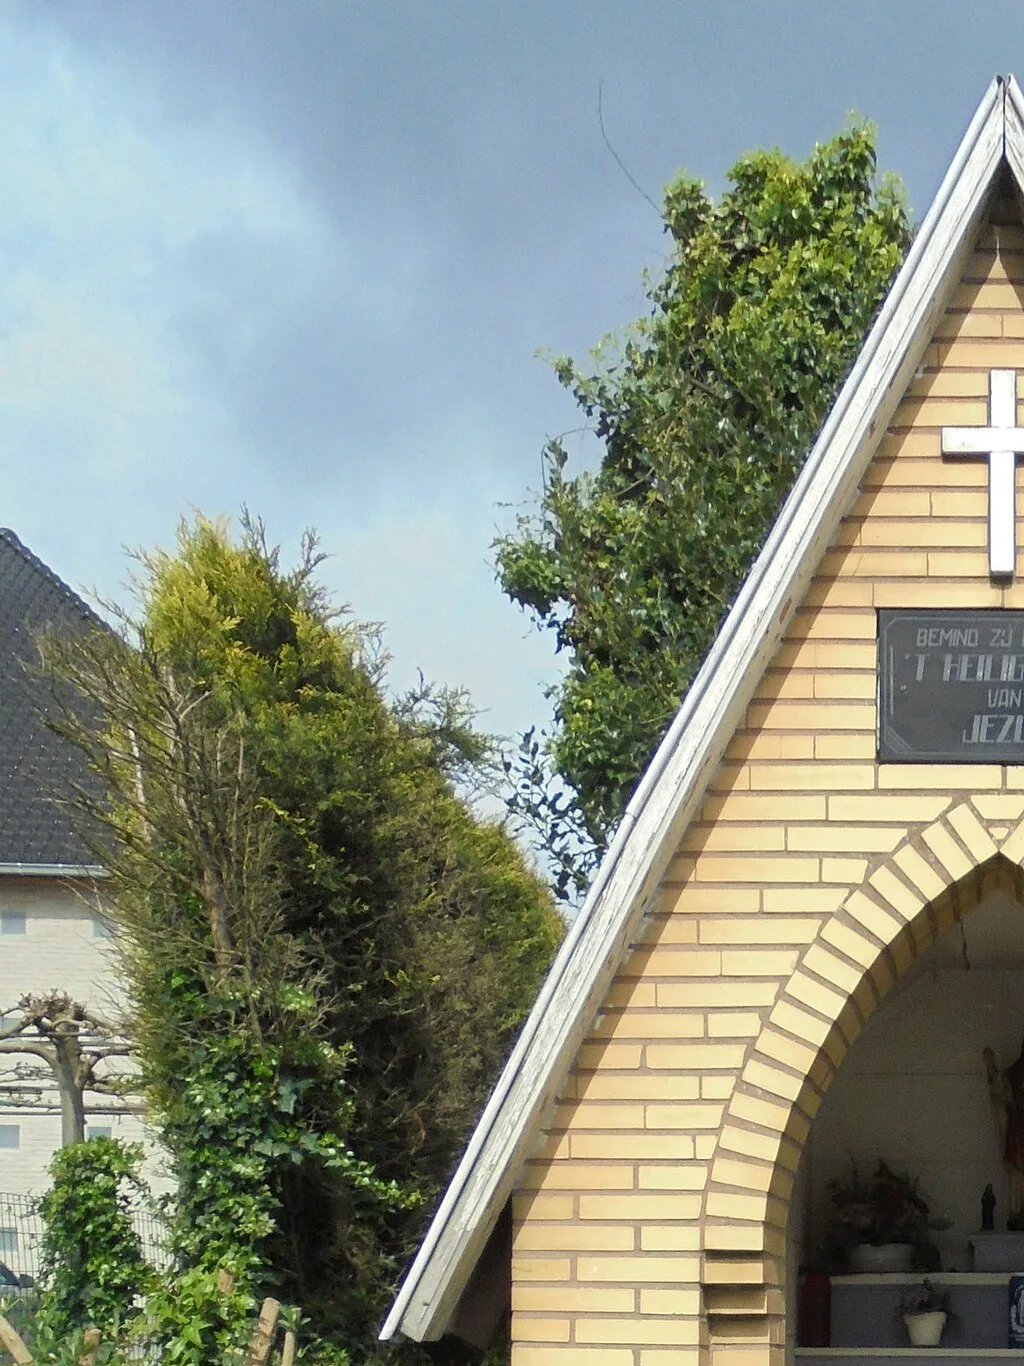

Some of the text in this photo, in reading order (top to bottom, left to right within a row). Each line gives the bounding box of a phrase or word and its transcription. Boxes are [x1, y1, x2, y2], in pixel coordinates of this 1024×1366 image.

[916, 628, 979, 648] BEMIND
[943, 653, 1024, 682] HEILIG
[988, 688, 1022, 709] VAN
